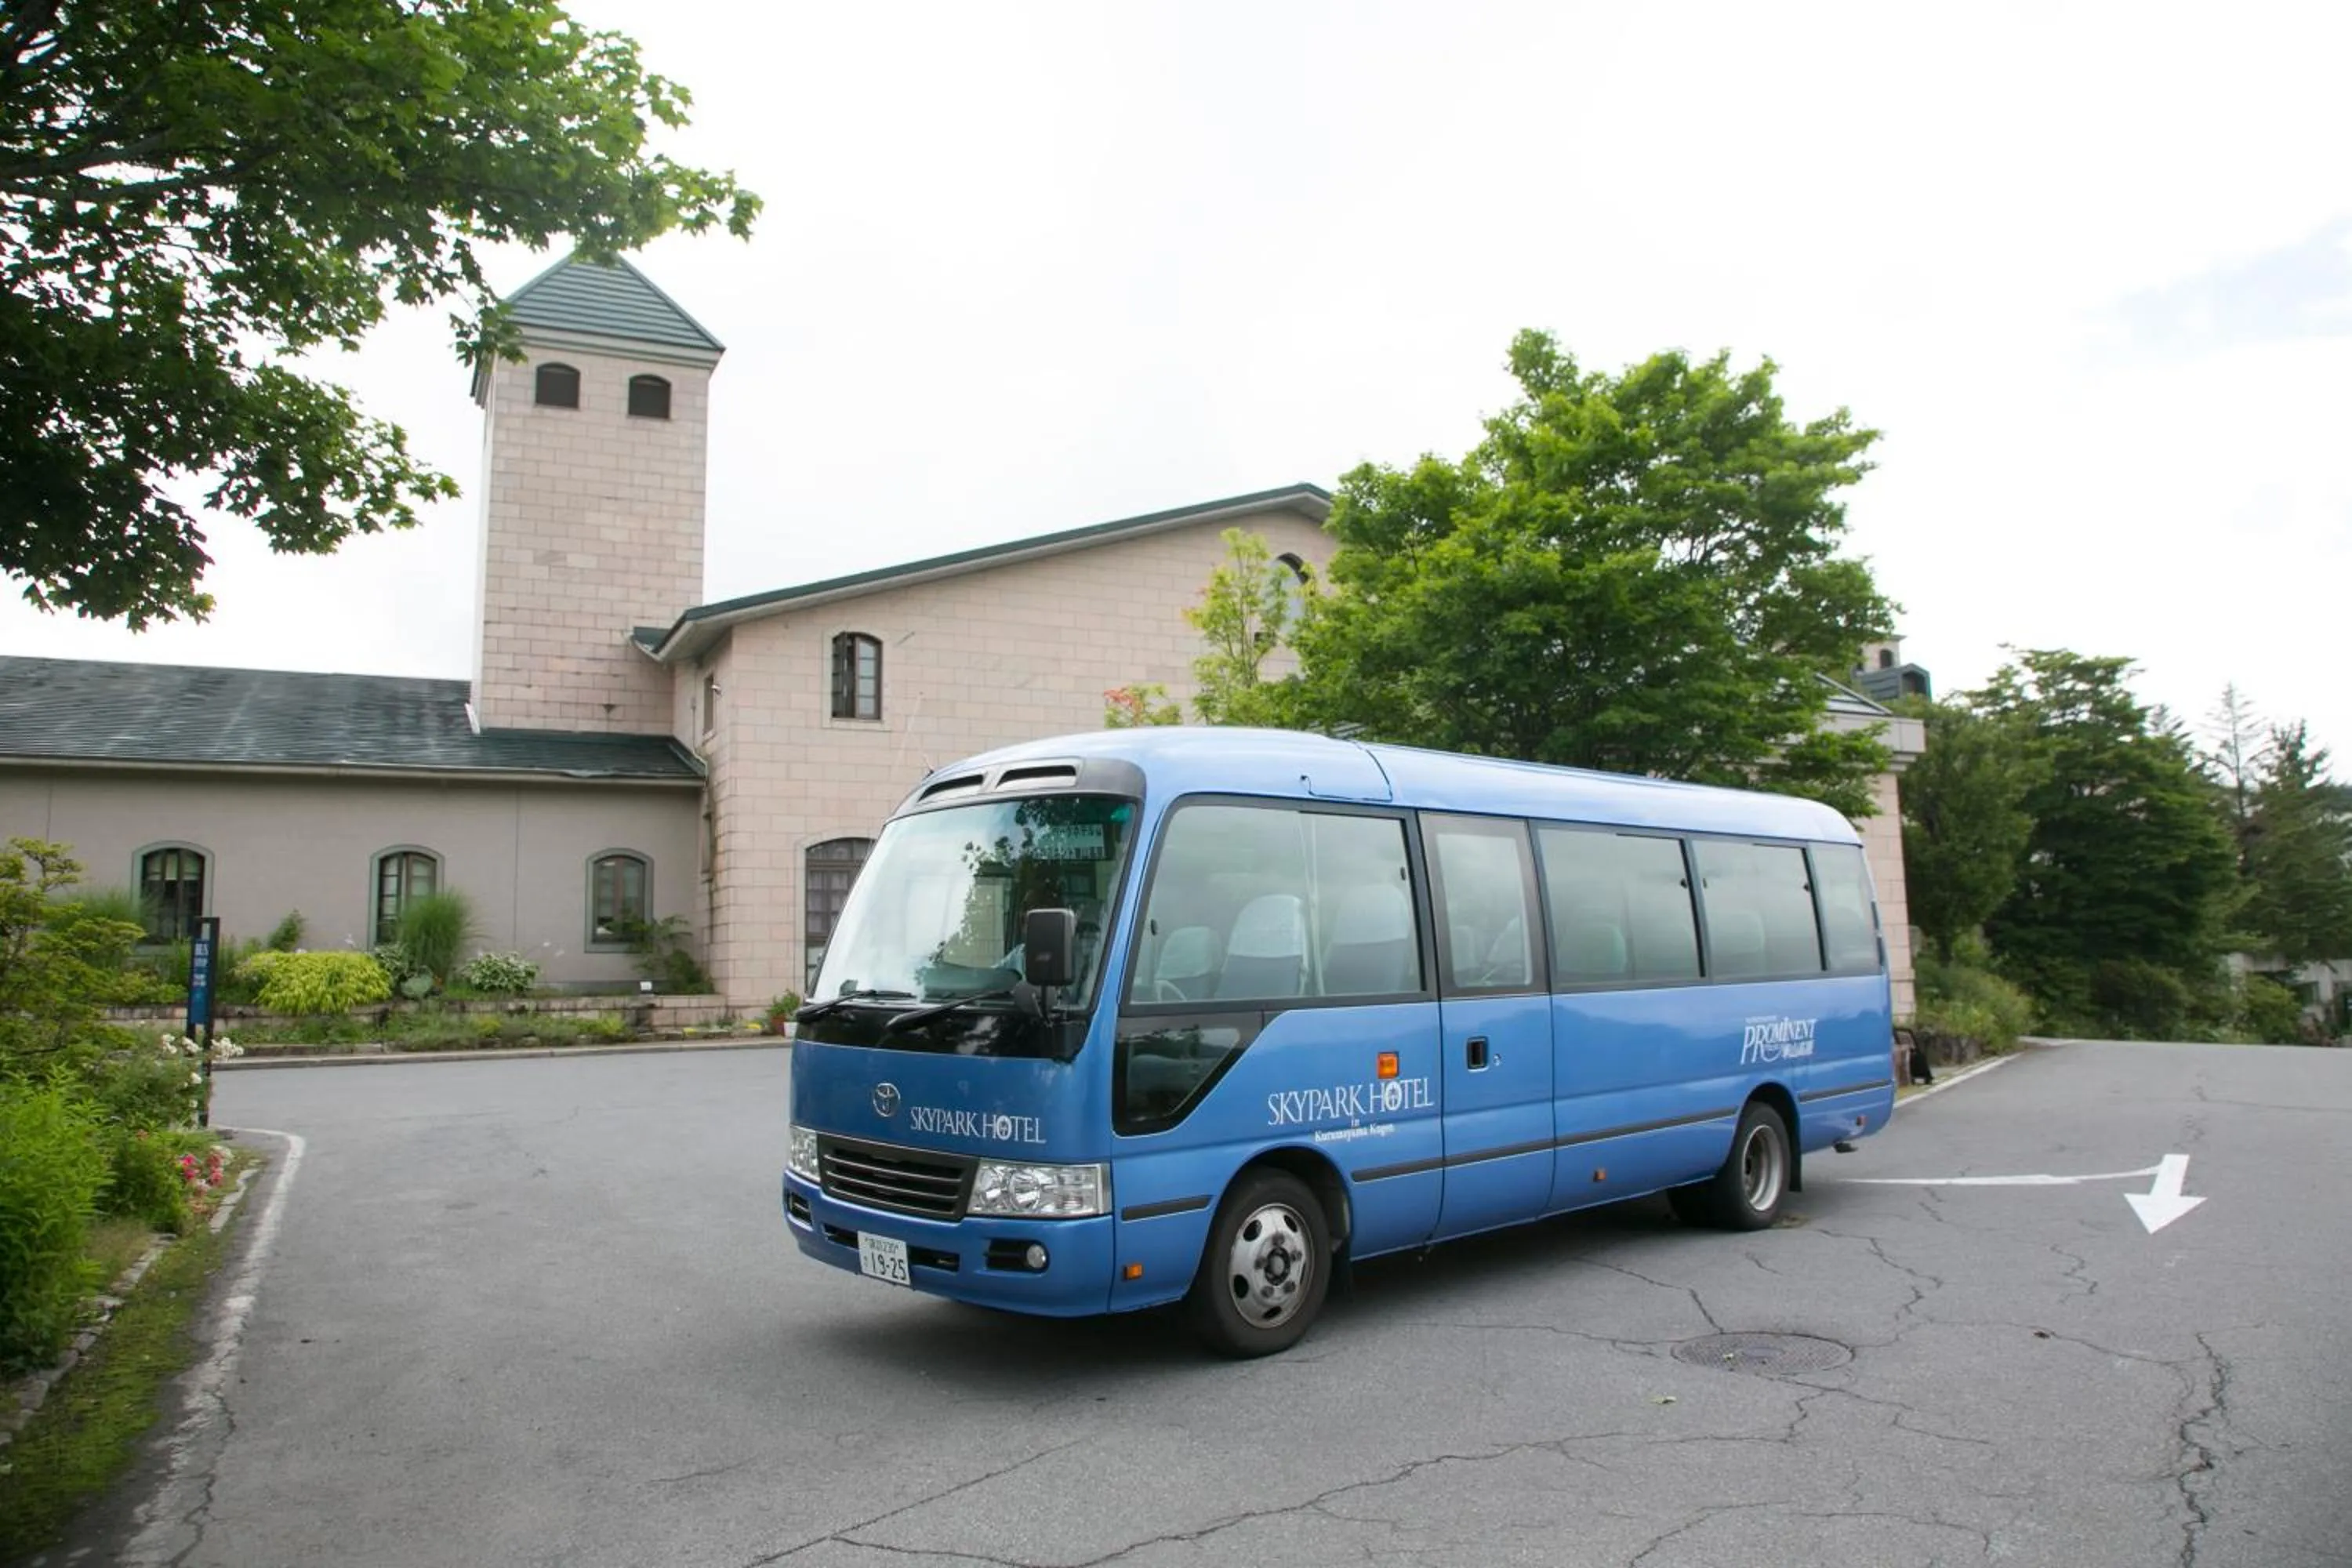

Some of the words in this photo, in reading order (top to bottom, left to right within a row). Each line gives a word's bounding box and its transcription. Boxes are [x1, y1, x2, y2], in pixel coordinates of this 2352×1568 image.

[1740, 1016, 1817, 1065] PROMINENT
[1267, 1085, 1366, 1127] SKYPARK
[1369, 1077, 1434, 1113] HOTEL
[910, 1106, 980, 1137] SKYPARK
[982, 1113, 1047, 1144] HOTEL
[871, 1251, 906, 1280] 19-25
